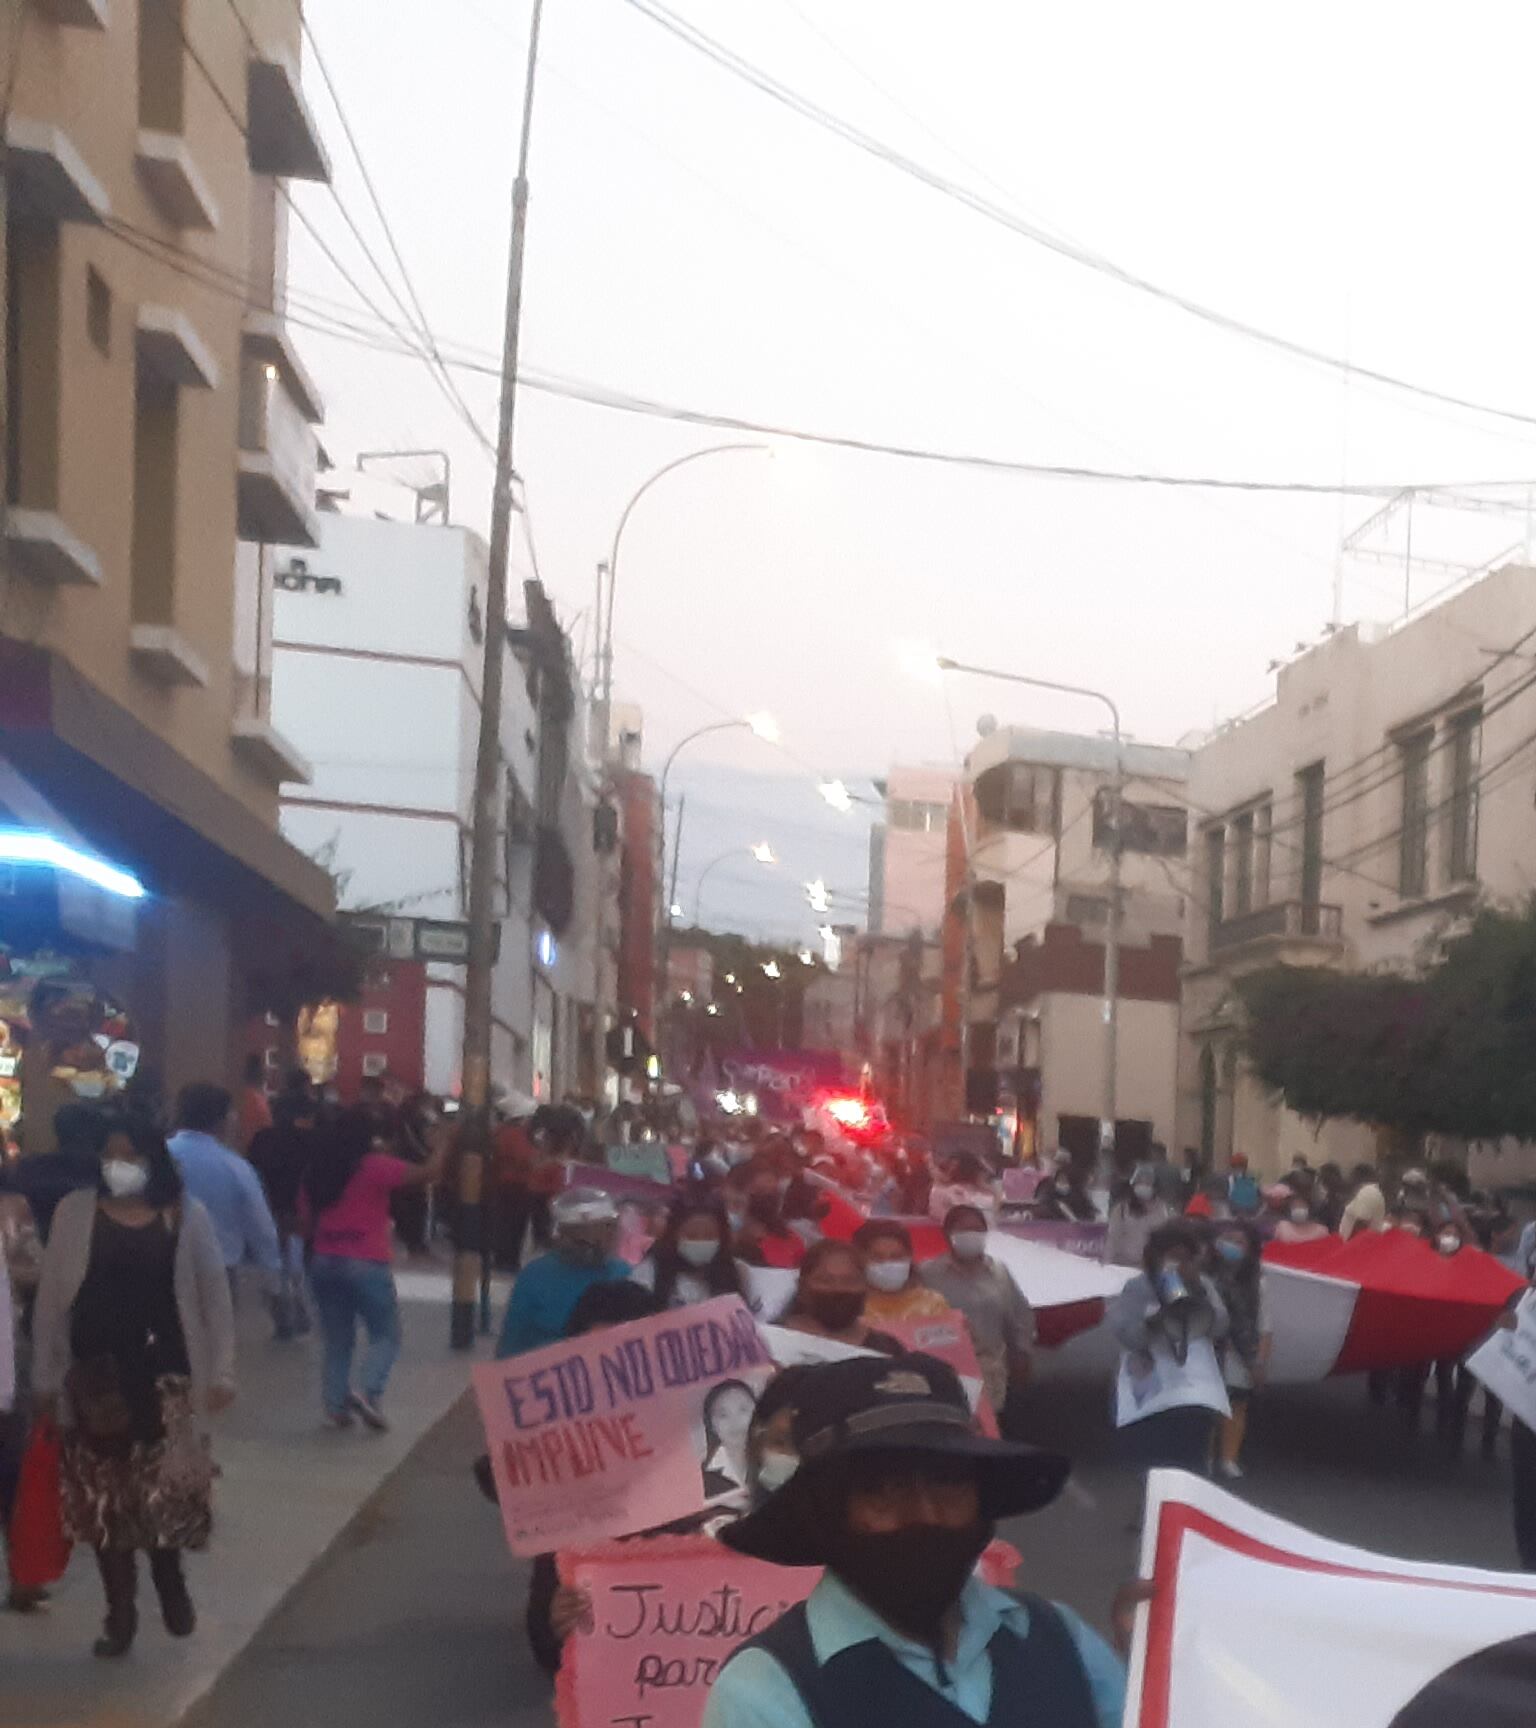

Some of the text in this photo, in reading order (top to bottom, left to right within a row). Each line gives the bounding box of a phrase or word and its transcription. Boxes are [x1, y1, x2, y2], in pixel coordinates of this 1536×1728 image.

[503, 1353, 594, 1430] ESTO
[600, 1336, 655, 1408] NO
[607, 1583, 788, 1639] Justic
[634, 1655, 714, 1698] par
